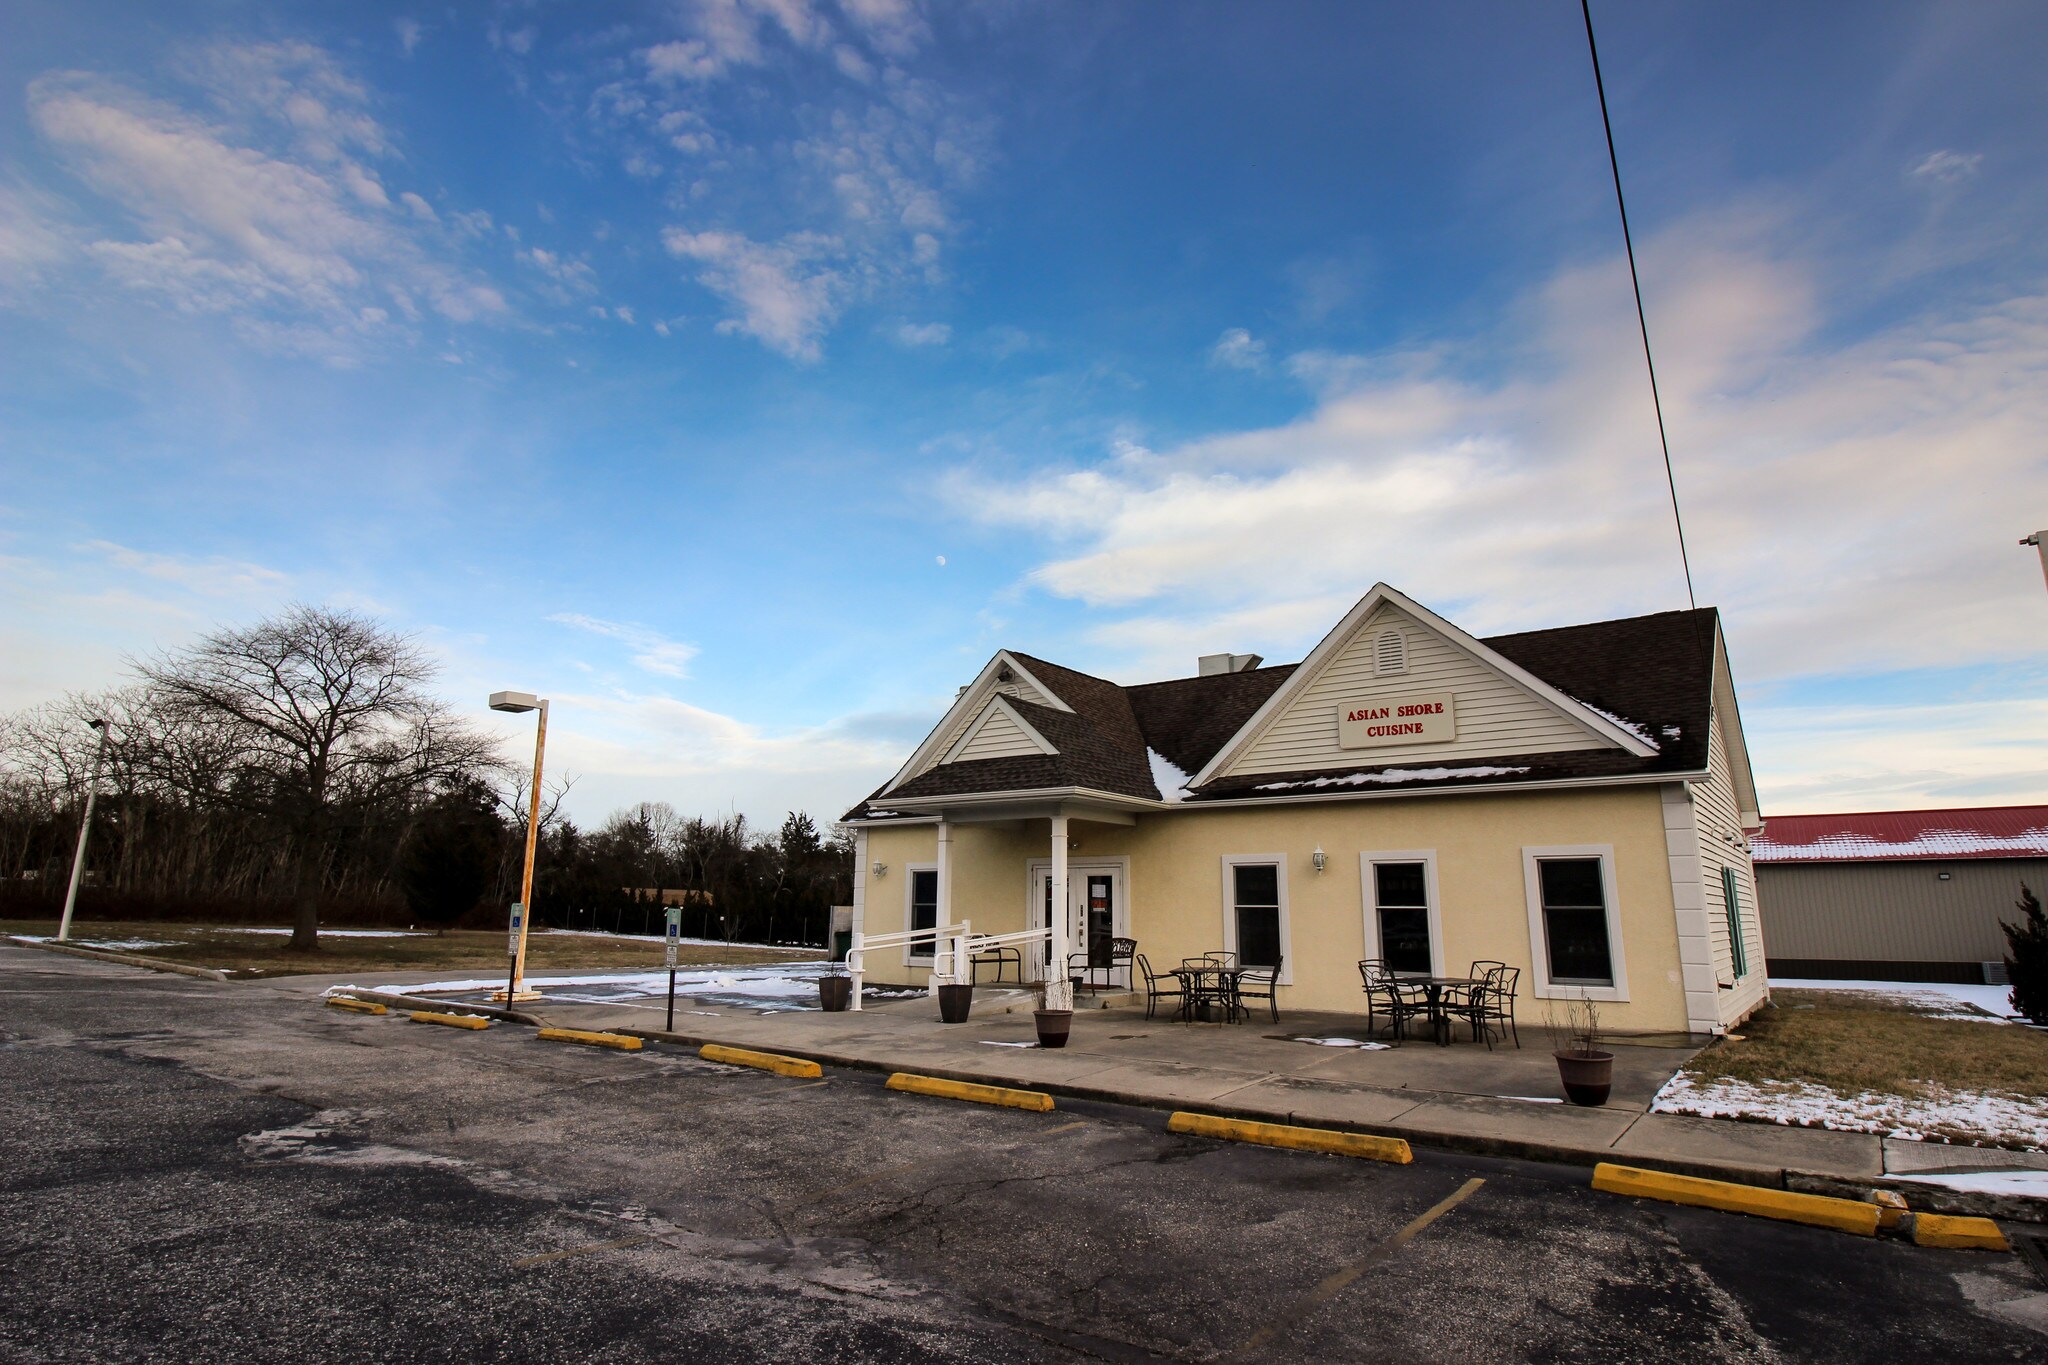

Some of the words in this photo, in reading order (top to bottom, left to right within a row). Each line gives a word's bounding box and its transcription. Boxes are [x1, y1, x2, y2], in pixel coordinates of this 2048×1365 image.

[1347, 707, 1390, 721] ASIAN
[1397, 702, 1444, 717] SHORE
[1366, 722, 1424, 737] CUISINE
